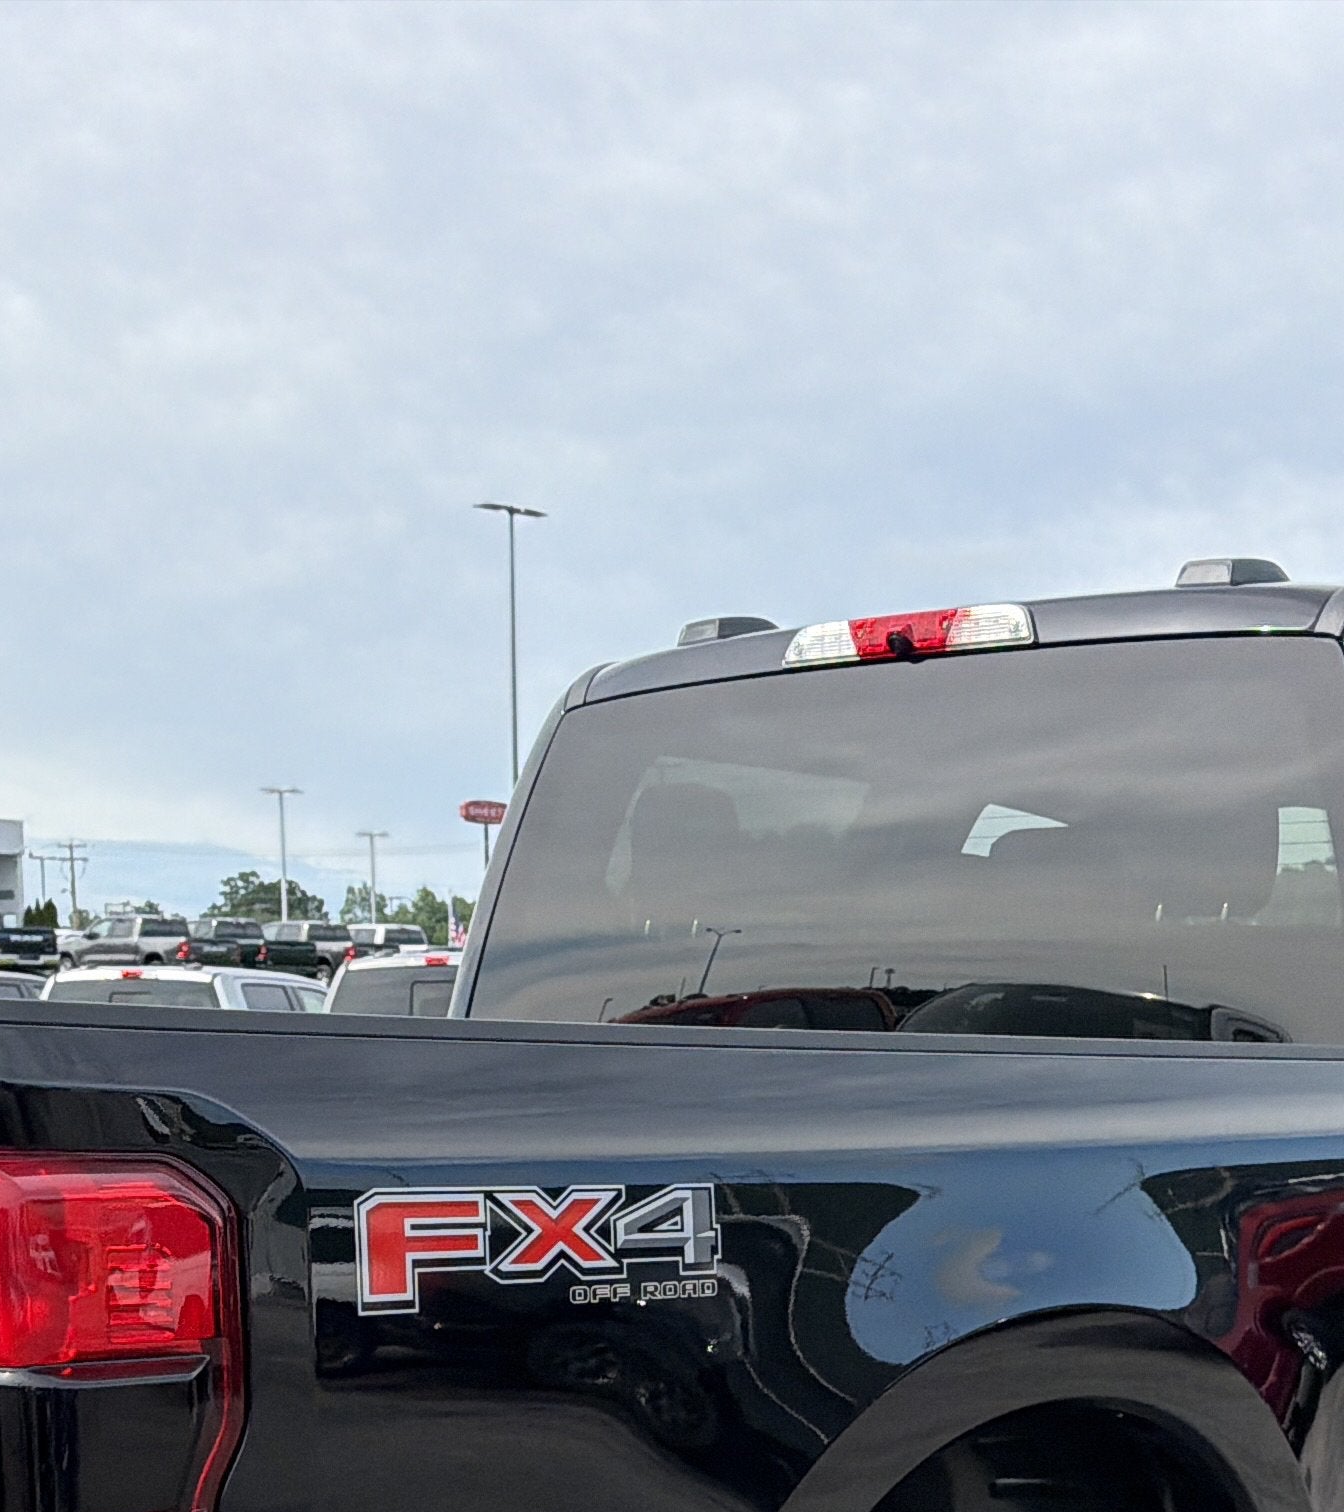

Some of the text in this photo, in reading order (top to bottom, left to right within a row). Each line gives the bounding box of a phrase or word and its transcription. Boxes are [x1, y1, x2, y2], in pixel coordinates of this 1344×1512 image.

[354, 1183, 722, 1317] FX4
[570, 1279, 718, 1304] OFF ROAD
